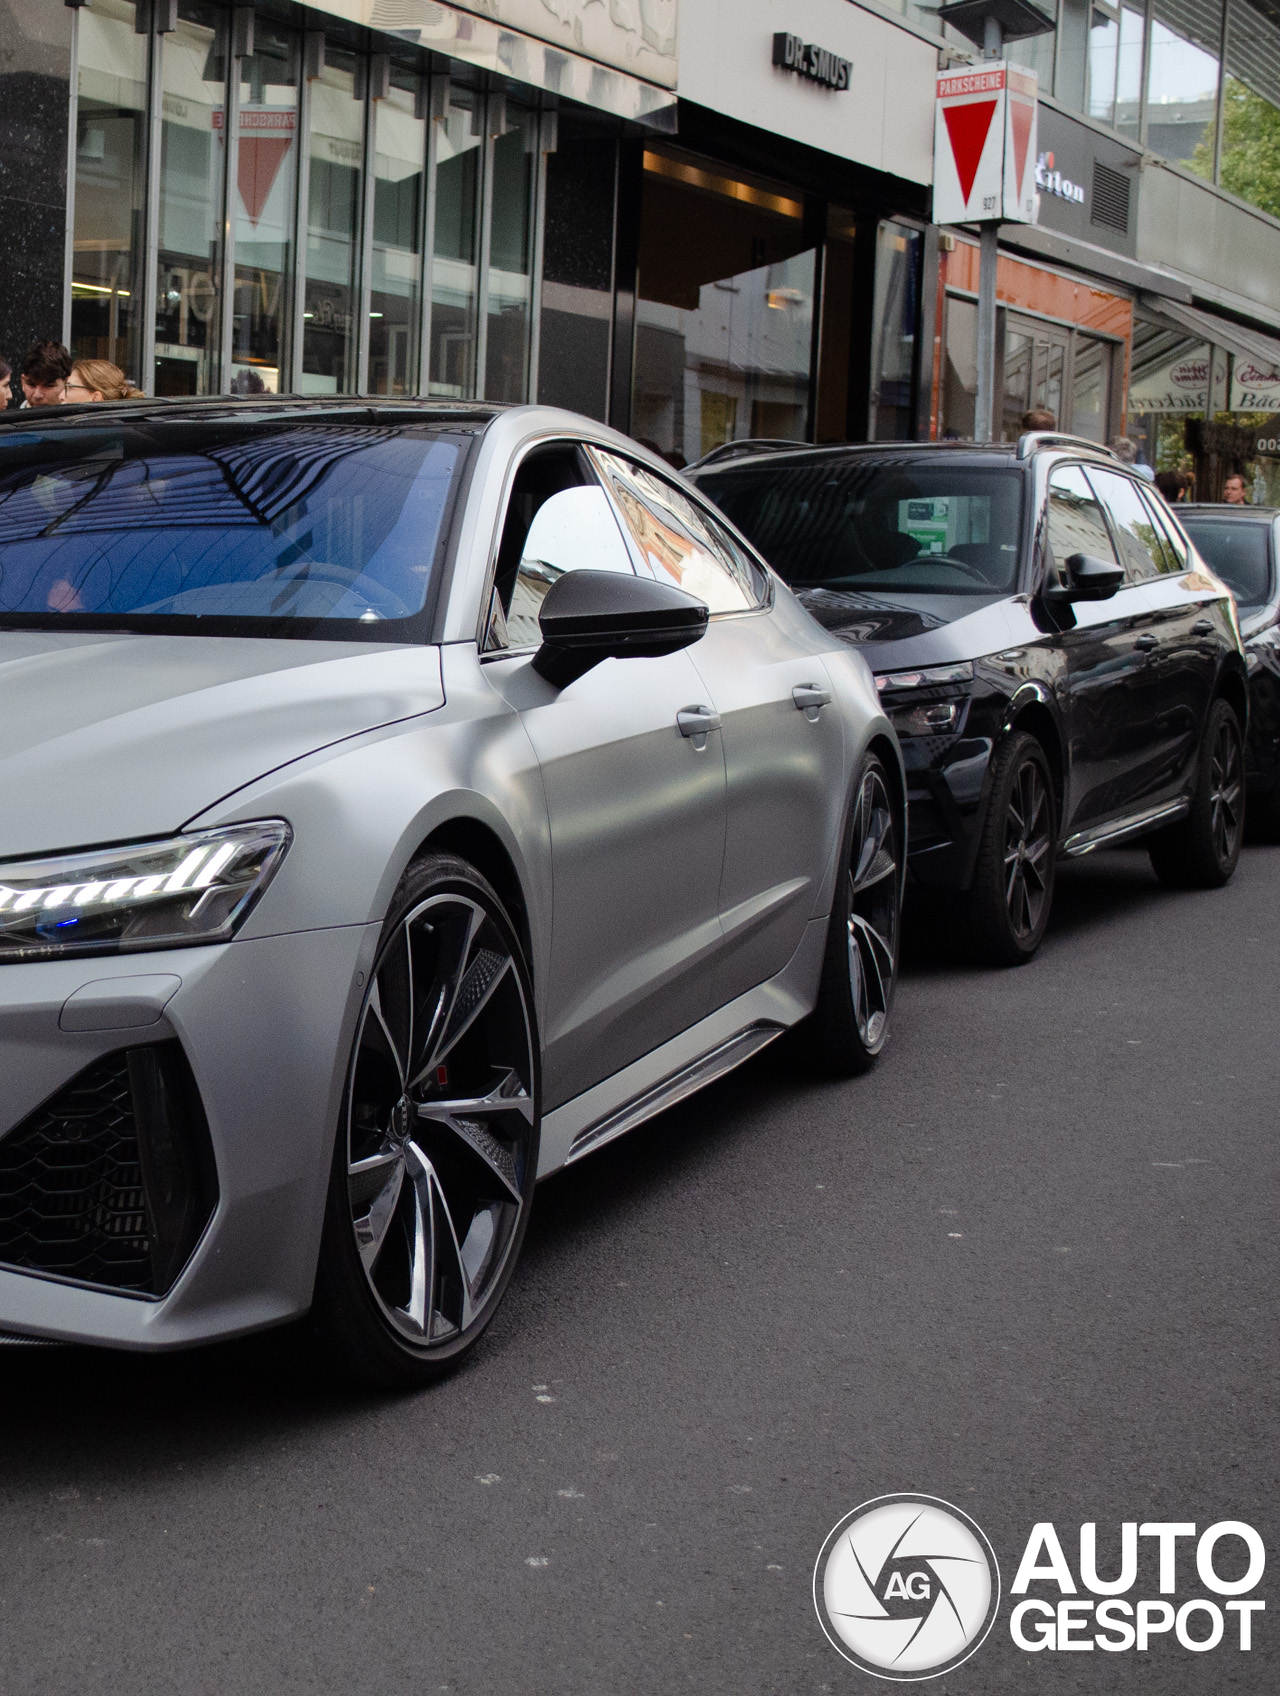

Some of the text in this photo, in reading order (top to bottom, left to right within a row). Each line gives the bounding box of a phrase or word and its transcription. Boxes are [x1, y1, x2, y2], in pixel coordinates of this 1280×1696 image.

[780, 32, 808, 73] DR.
[939, 72, 1002, 96] PARKSCHEINE
[983, 196, 996, 210] 927
